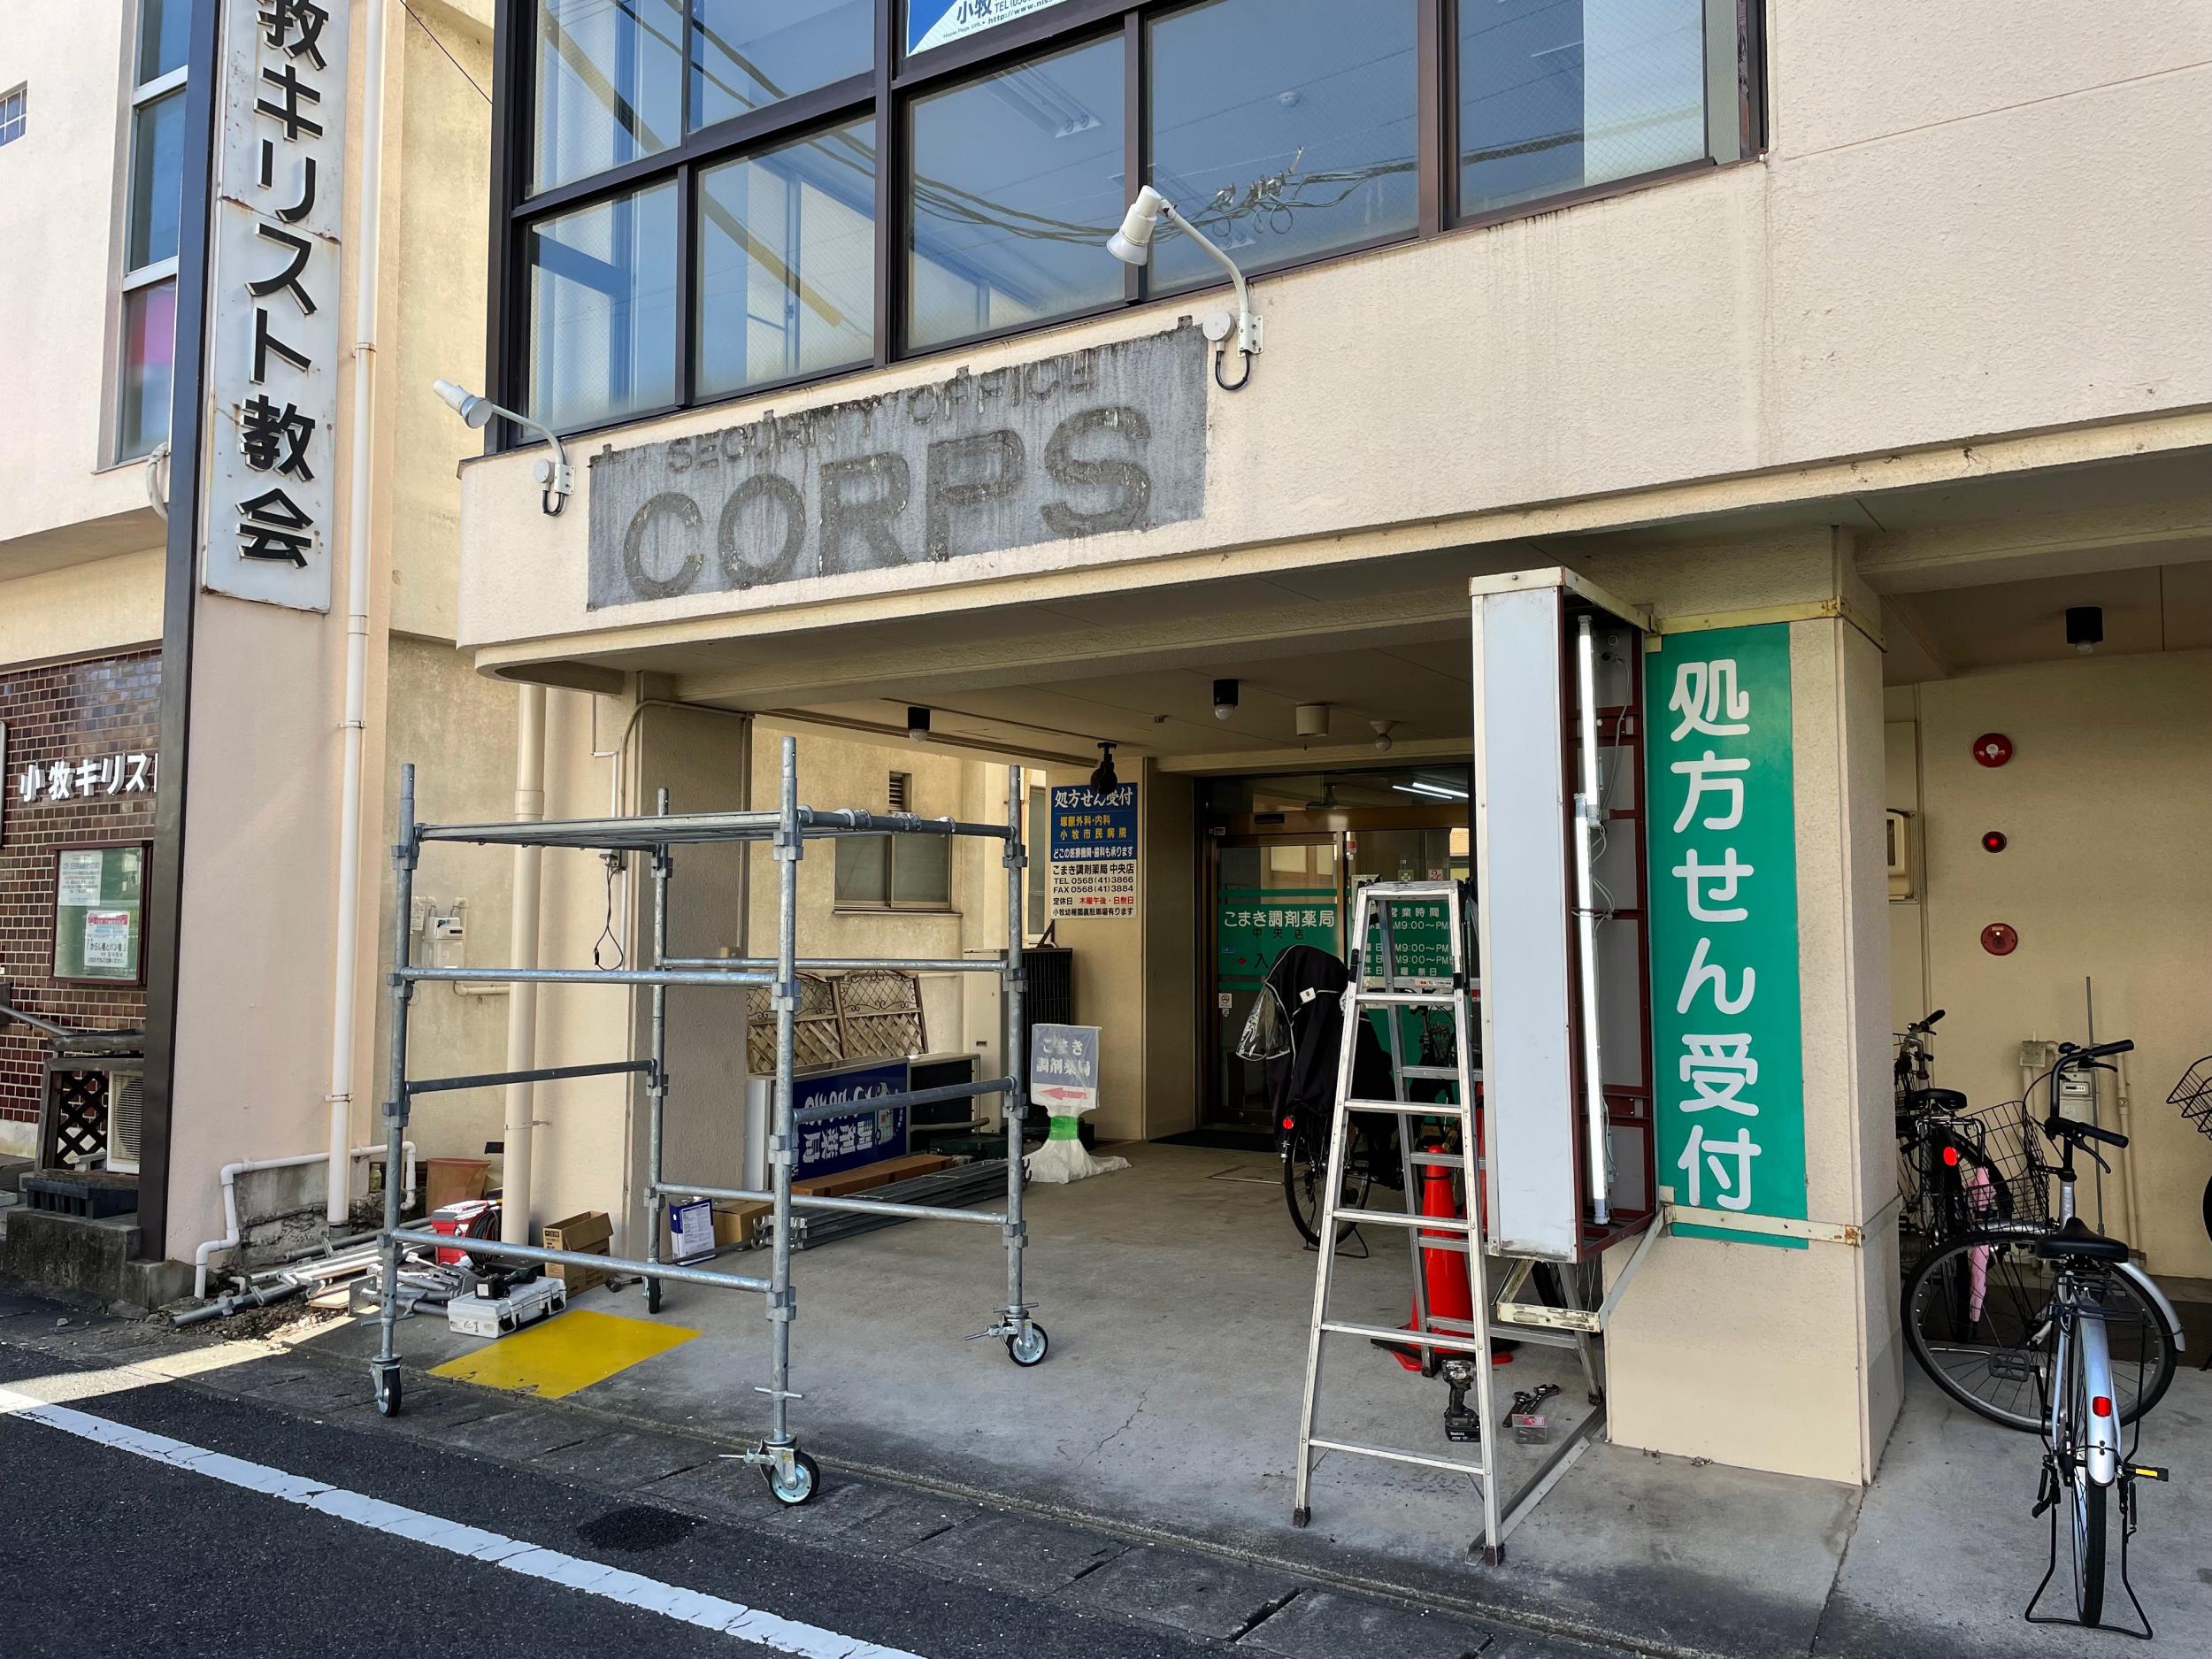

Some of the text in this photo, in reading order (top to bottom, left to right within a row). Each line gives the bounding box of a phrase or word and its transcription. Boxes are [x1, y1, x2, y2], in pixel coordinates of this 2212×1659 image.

[995, 0, 1009, 12] TEL
[623, 405, 1152, 599] CORPS
[1055, 787, 1133, 809] 処方せん受付
[1053, 864, 1134, 875] こまき調剤薬局 中央店
[1224, 910, 1335, 927] こまき調剤薬局
[1252, 928, 1304, 941] 中央店
[1668, 658, 1762, 1211] 処方せん受付
